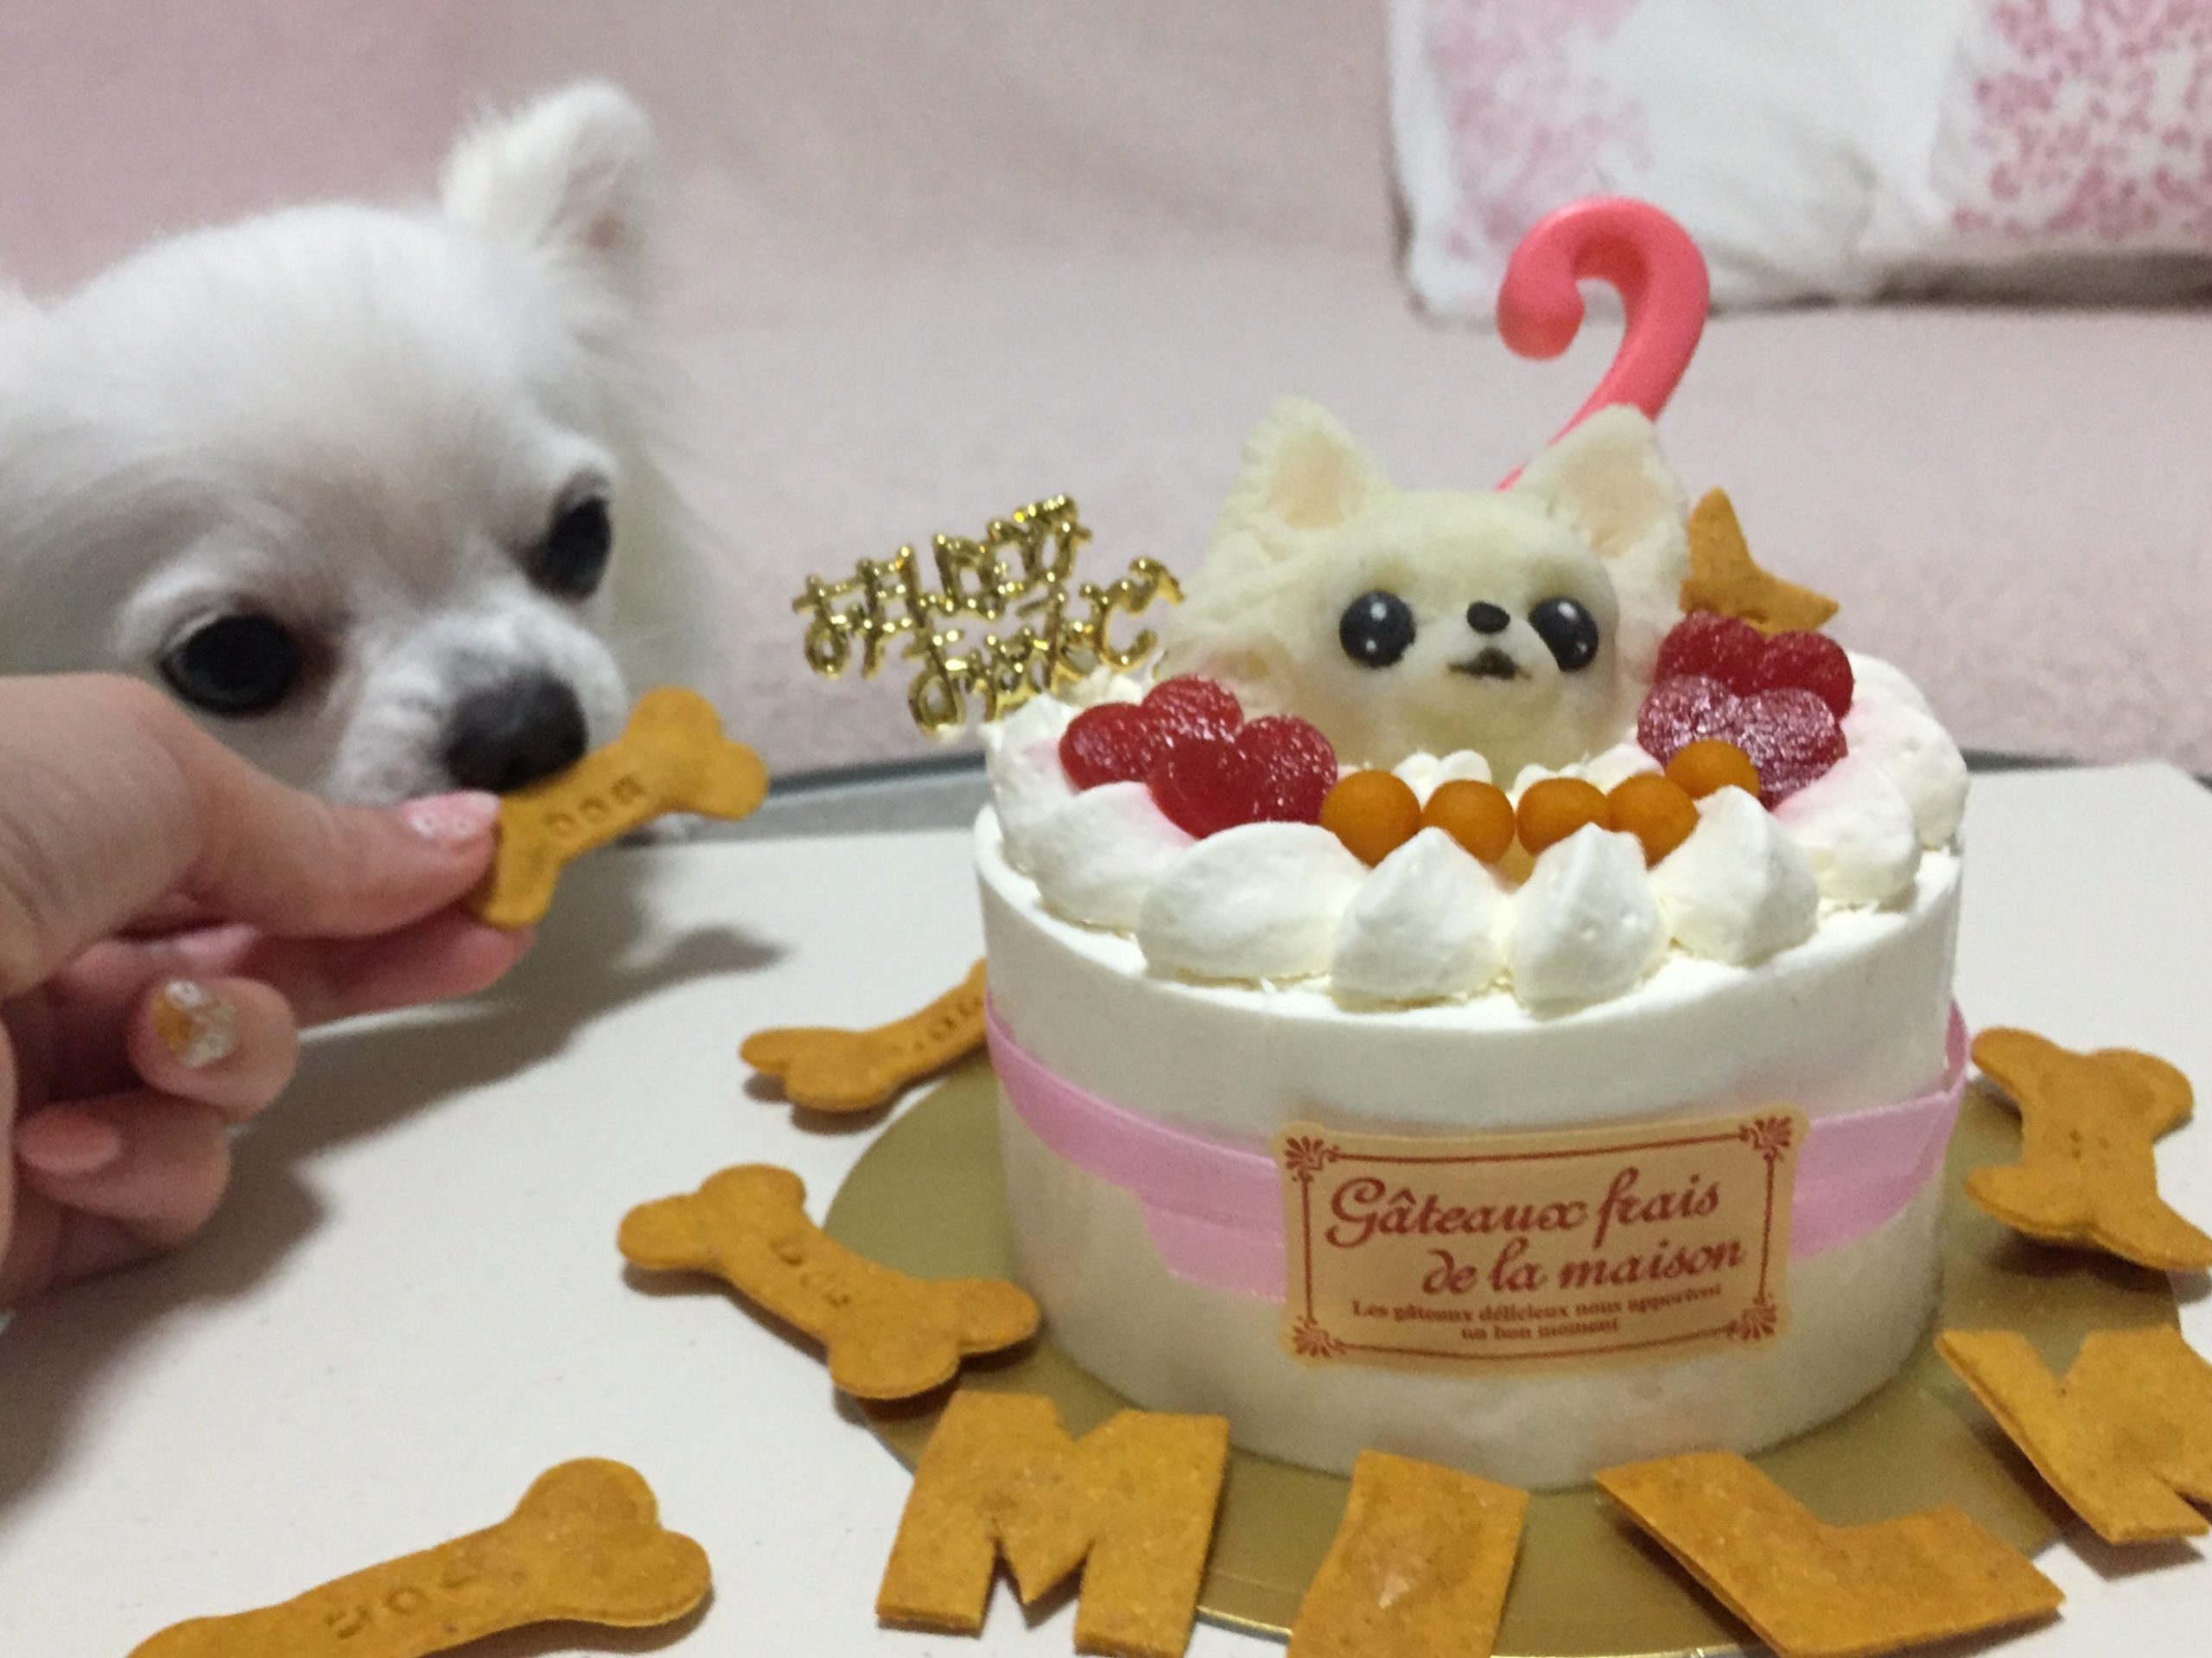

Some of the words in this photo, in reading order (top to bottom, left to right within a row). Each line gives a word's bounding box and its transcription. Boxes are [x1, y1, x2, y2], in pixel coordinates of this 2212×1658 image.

[1325, 1176, 1590, 1248] Gâteaux
[1592, 1166, 1721, 1249] frais
[1421, 1248, 1478, 1295] de
[1488, 1236, 1550, 1293] la
[1557, 1237, 1748, 1290] maison
[1352, 1299, 1389, 1318] Les
